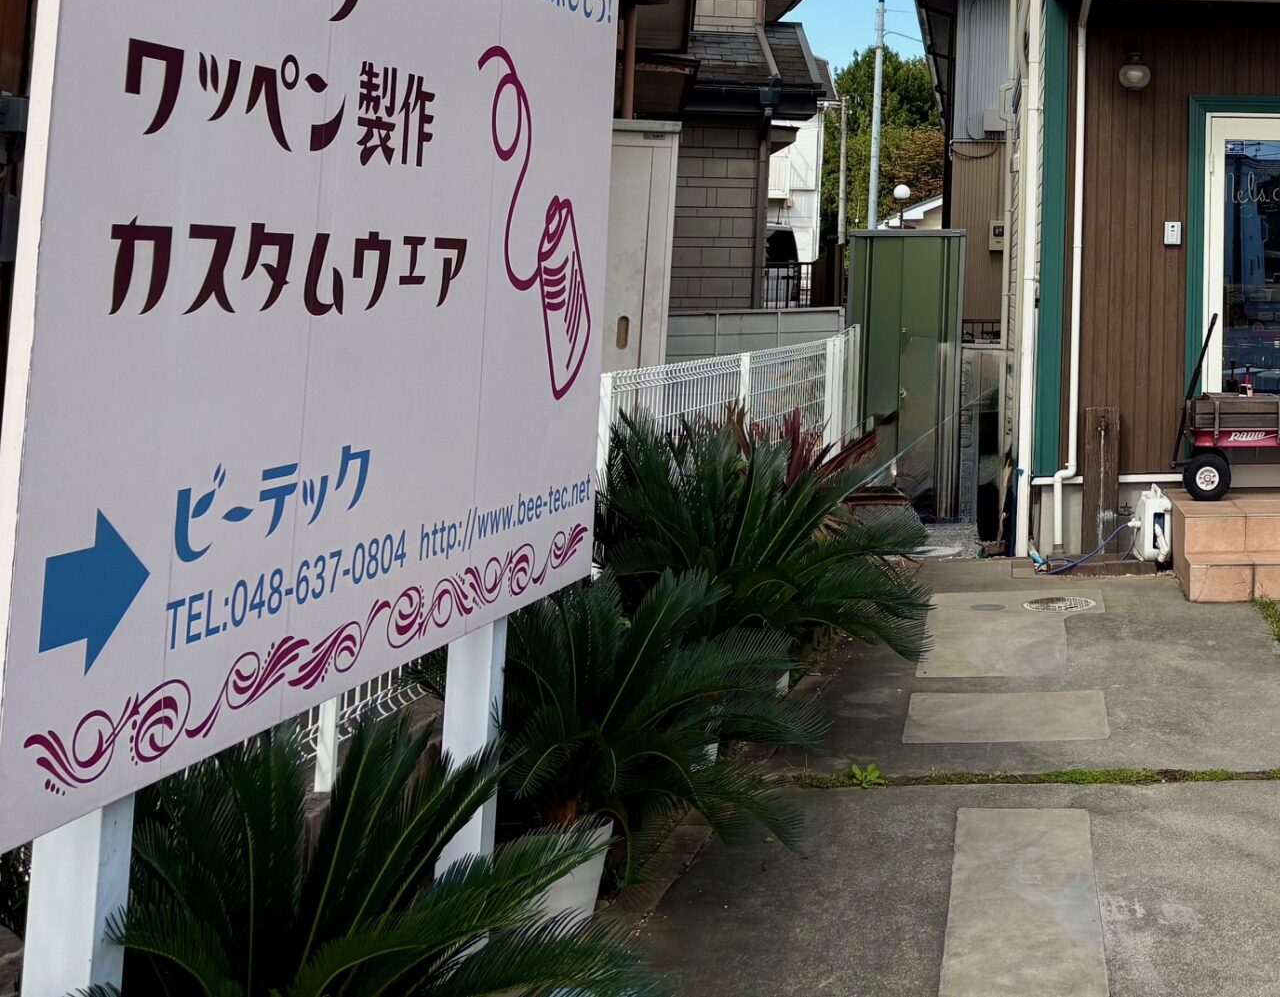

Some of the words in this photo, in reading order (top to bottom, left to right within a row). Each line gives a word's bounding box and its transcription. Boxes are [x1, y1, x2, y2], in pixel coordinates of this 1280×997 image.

[125, 37, 436, 167] ワッペン製作
[1229, 431, 1266, 441] RADIO
[166, 529, 408, 650] TEL:048-637-0804
[419, 473, 591, 562] http://www.bee-tec.net
[174, 444, 371, 563] ビーテック
